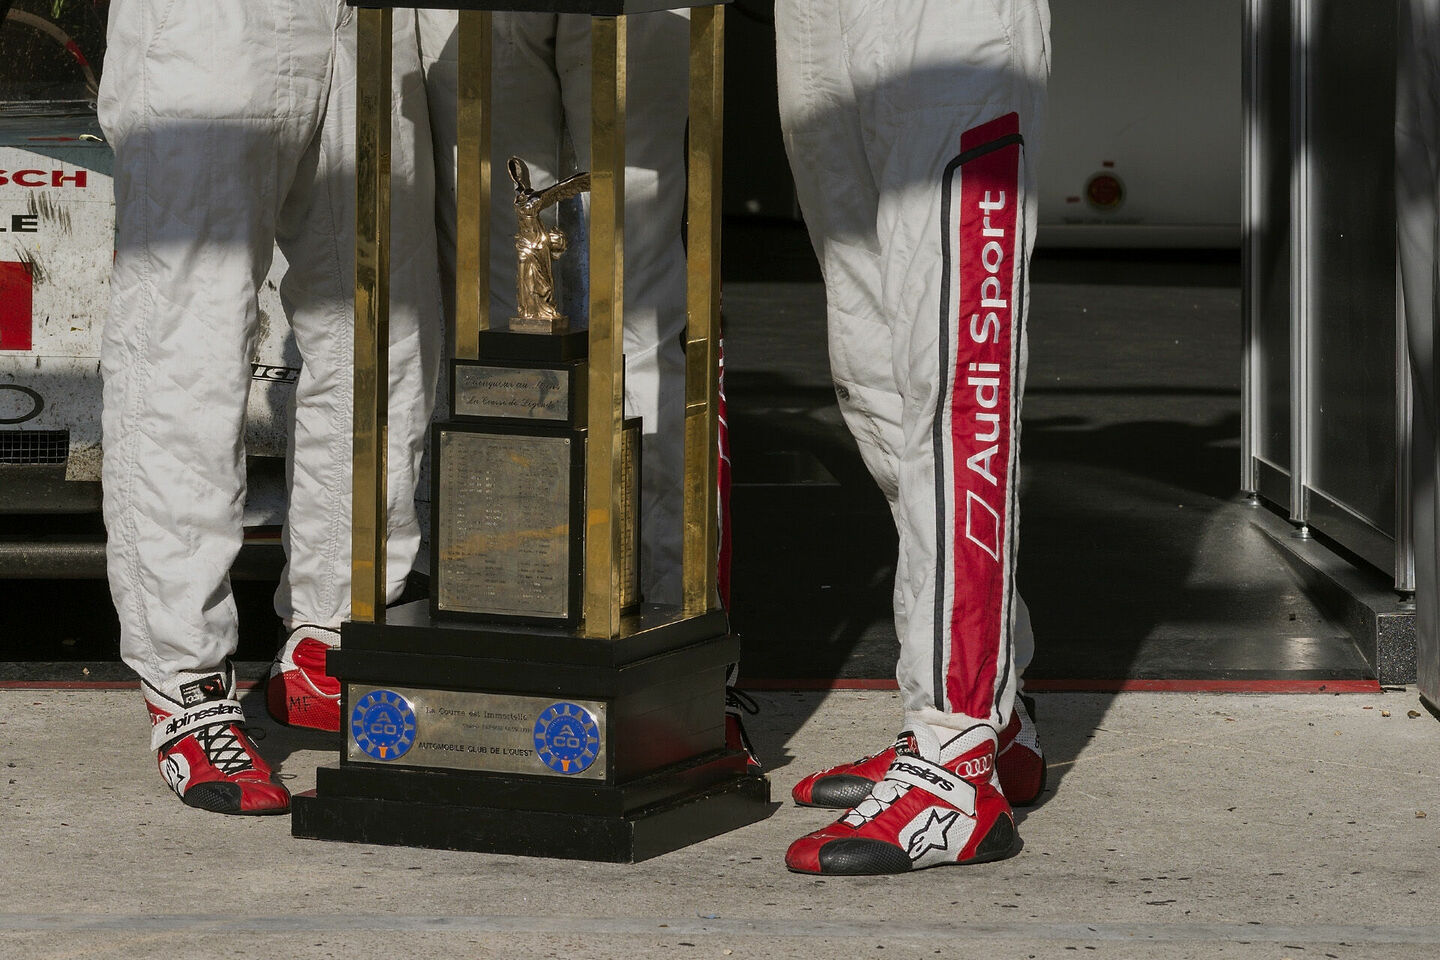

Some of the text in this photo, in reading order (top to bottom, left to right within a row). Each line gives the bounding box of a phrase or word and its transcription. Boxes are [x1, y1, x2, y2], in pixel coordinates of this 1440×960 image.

[967, 190, 1007, 486] Audi Sport
[165, 703, 243, 735] alpinestars
[418, 741, 465, 752] AUTOMOBILE
[467, 745, 487, 754] CLUB
[490, 747, 500, 755] DE
[888, 762, 955, 792] nestars
